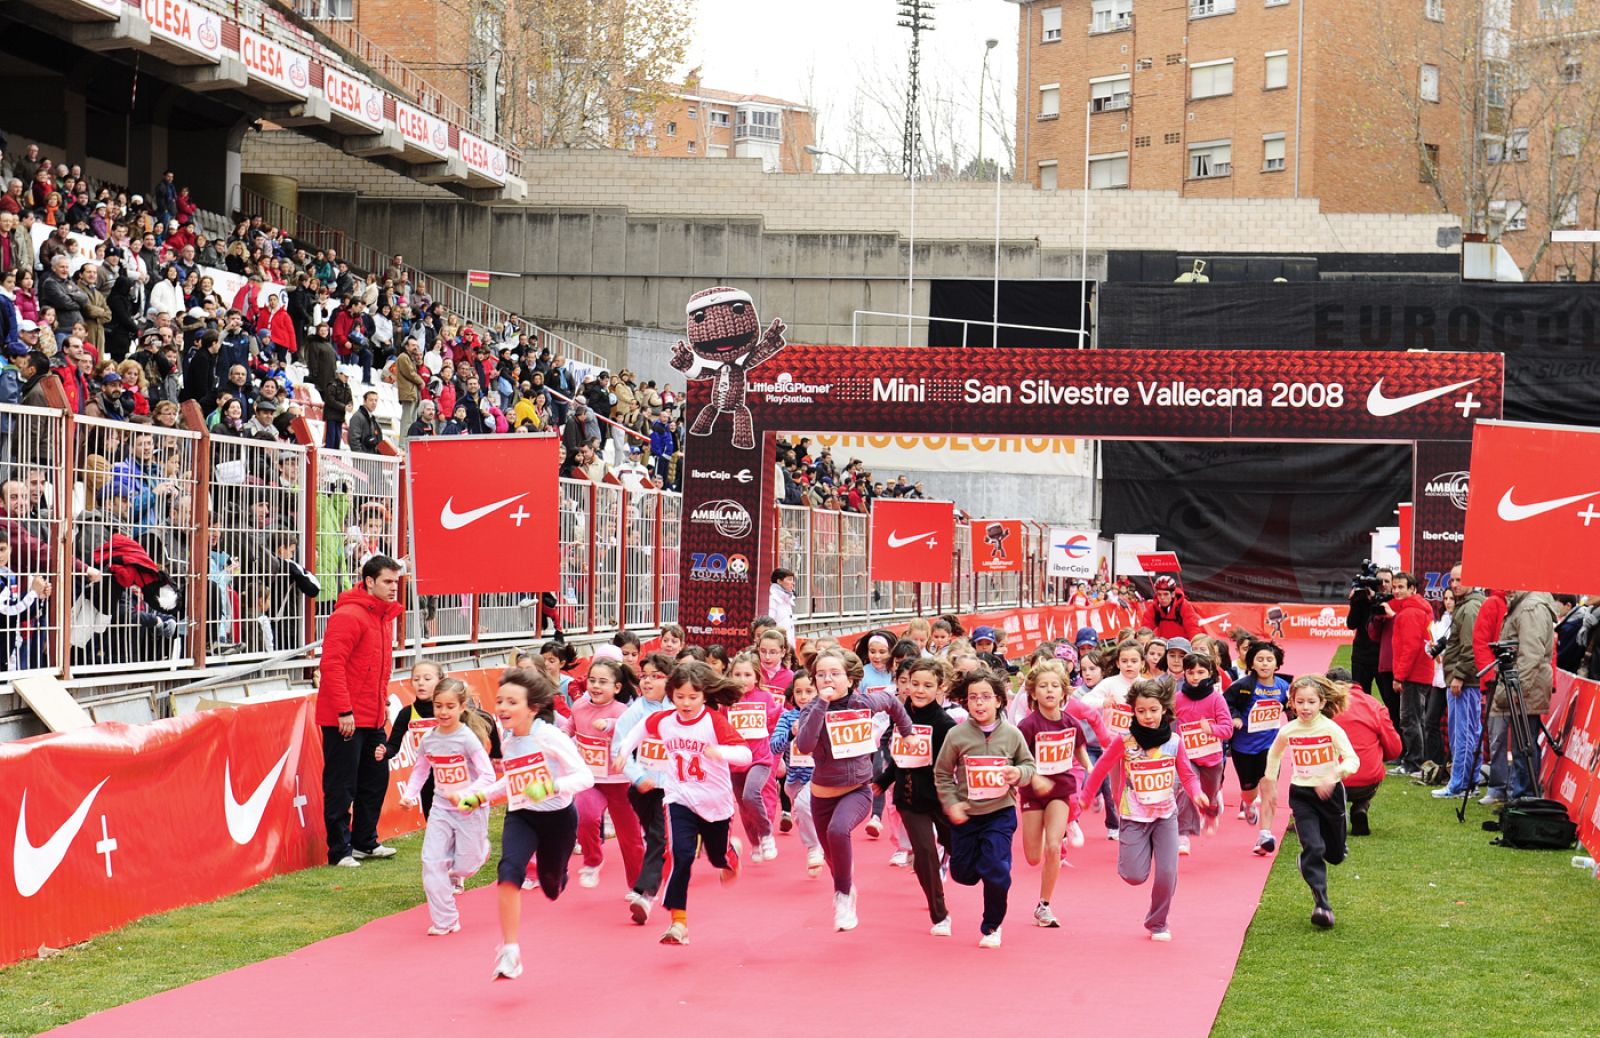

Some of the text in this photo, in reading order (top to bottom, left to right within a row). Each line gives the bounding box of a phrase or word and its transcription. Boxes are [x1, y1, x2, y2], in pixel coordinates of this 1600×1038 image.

[144, 0, 192, 40] CLESA
[243, 36, 283, 81] CLESA
[327, 74, 362, 114] CLESA
[399, 108, 430, 145] CLESA
[461, 137, 489, 171] CLESA
[872, 377, 1344, 408] Mini San Silvestre Vallecana 2008
[691, 509, 749, 521] AMBILAMP
[731, 714, 764, 729] 1203
[1251, 708, 1280, 723] 1023
[831, 723, 872, 745] 1012
[1039, 742, 1072, 763] 1173
[1294, 746, 1331, 766] 1011
[675, 752, 705, 783] 14
[967, 770, 1007, 788] 1106
[1134, 772, 1173, 792] 1009
